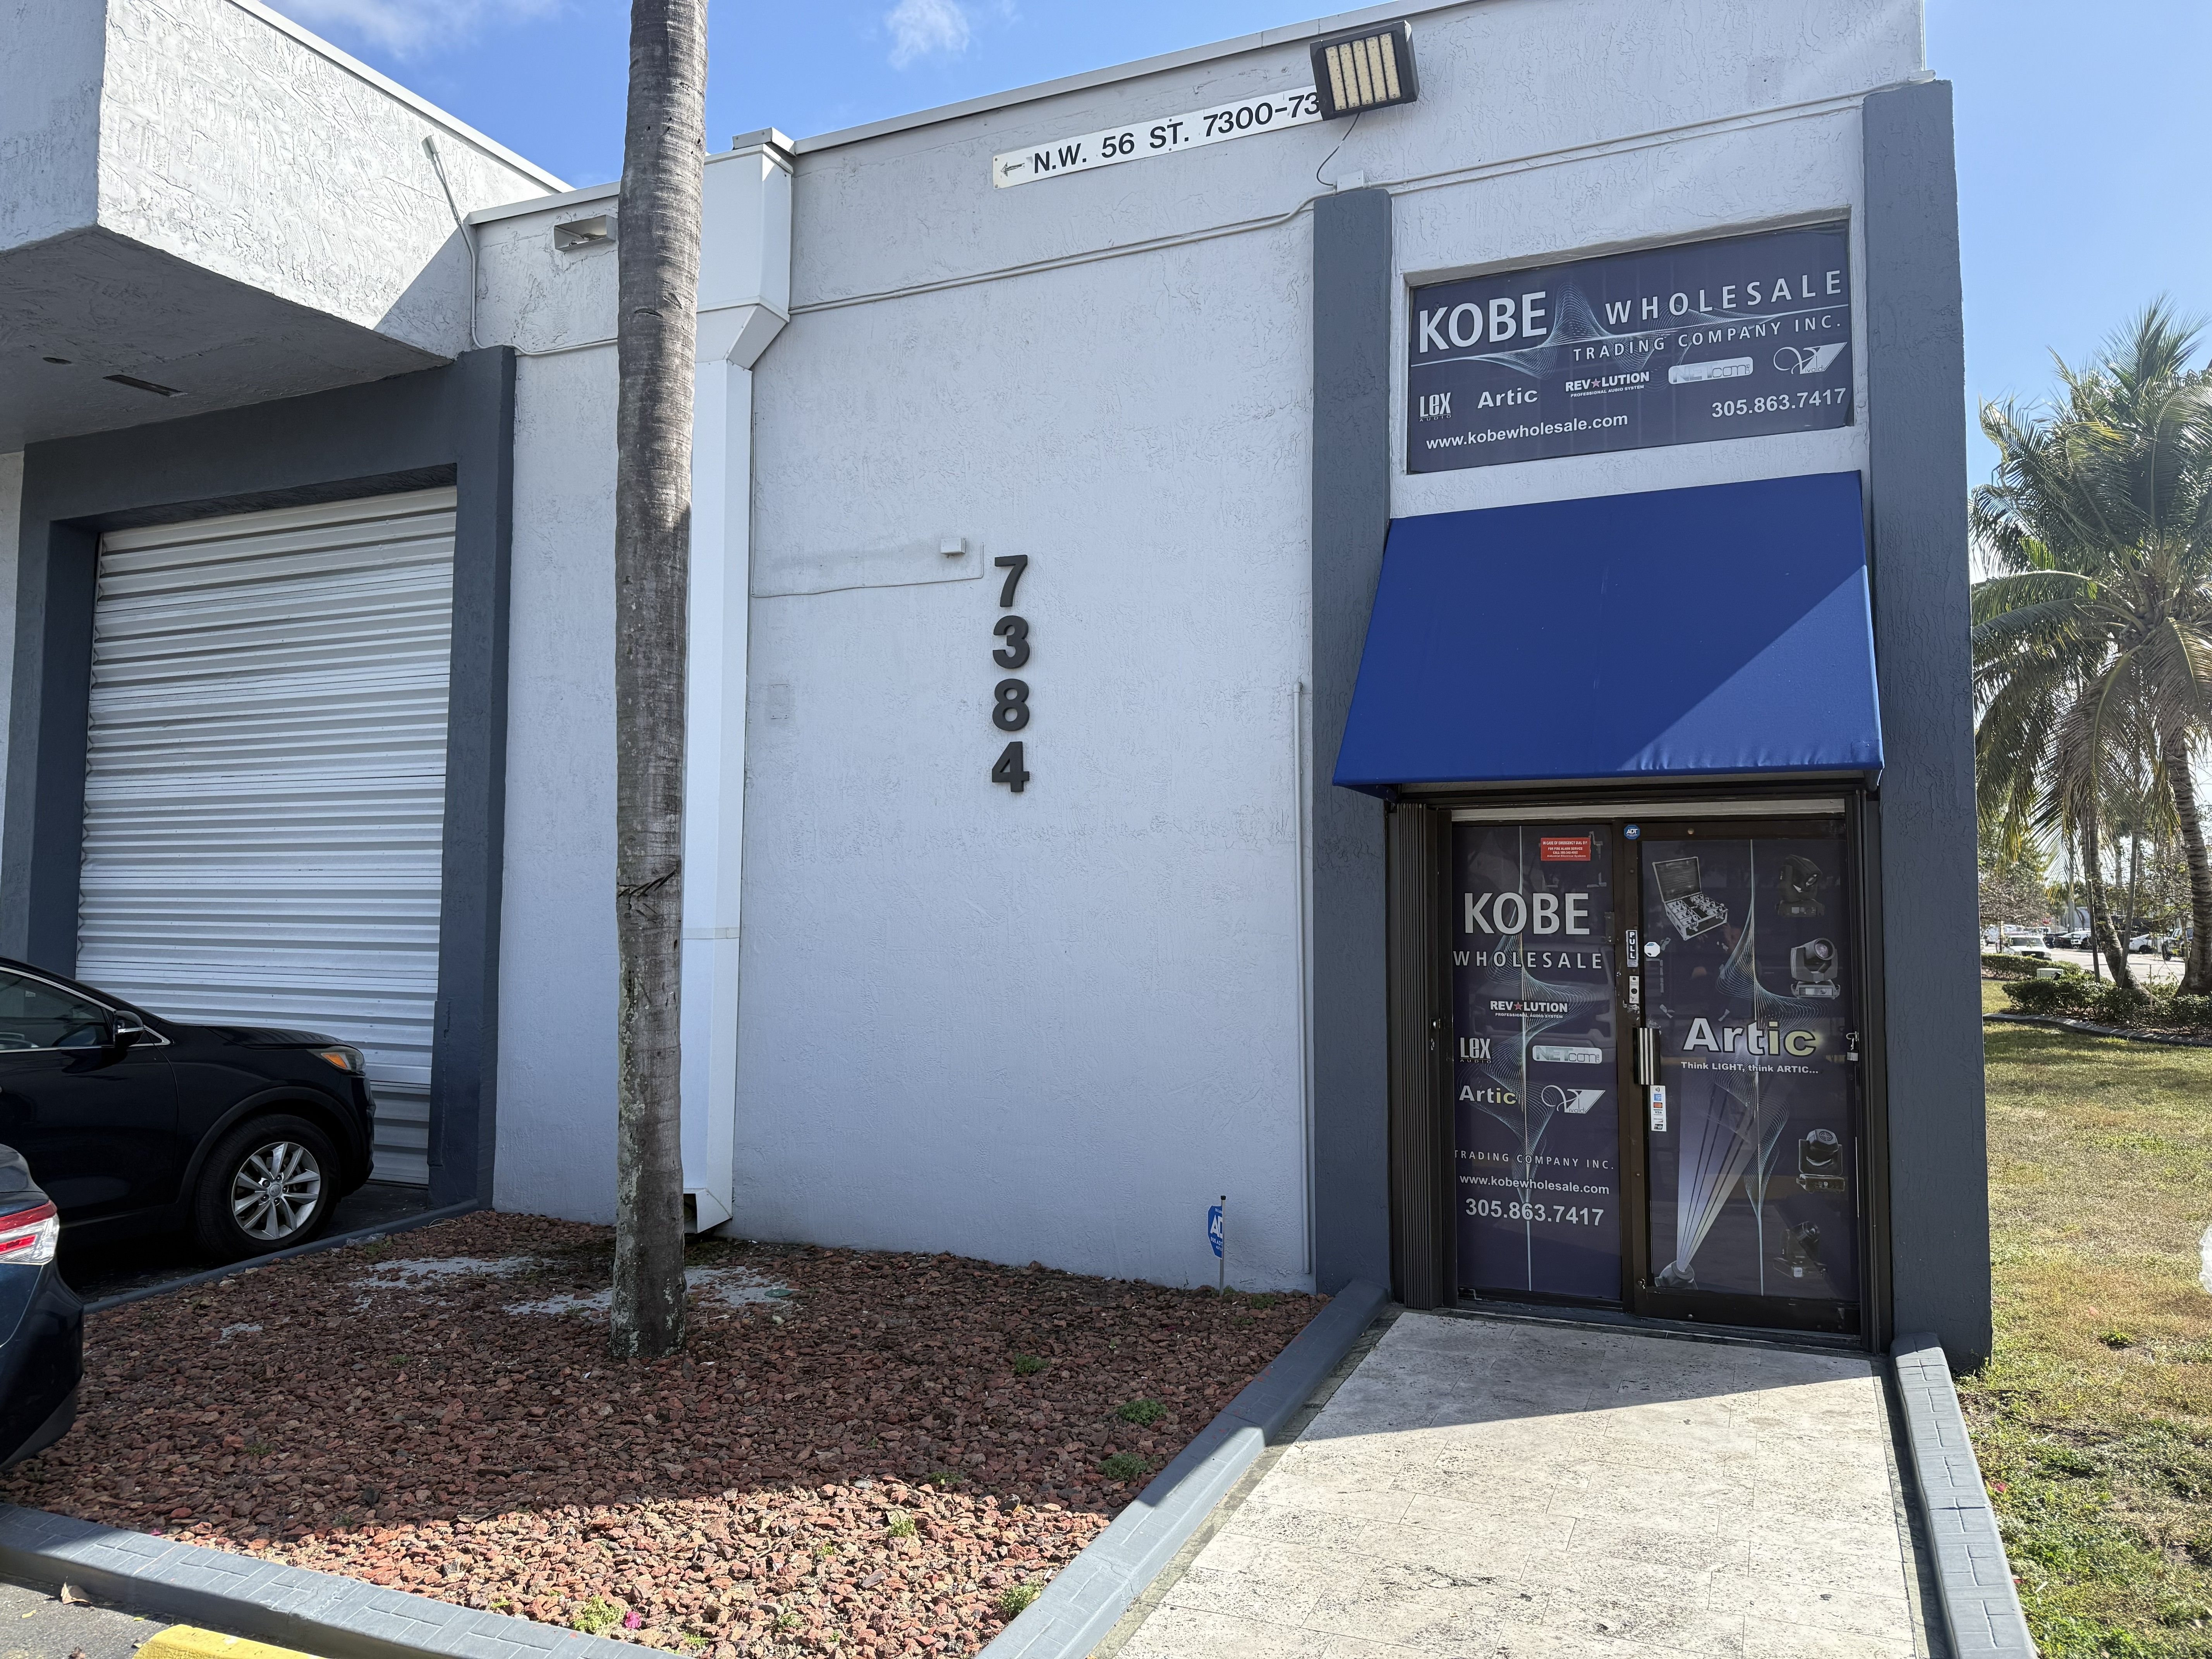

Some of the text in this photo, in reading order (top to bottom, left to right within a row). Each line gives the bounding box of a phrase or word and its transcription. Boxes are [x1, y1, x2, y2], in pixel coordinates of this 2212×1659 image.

[1034, 143, 1087, 174] N.W.
[1101, 132, 1135, 158] 56
[1149, 122, 1189, 149] ST.
[1606, 270, 1841, 325] WHOLESALE
[1419, 291, 1547, 353] KOBE
[1573, 315, 1841, 361] TRADING COMPANY INC.
[1478, 388, 1538, 409] Artic
[1571, 389, 1607, 398] PROFESSIONAL
[1712, 388, 1846, 417] 305.863.7417
[1426, 414, 1628, 449] www.kobewholesale.com
[992, 555, 1030, 792] 7384
[1465, 892, 1590, 934] KOBE
[1453, 951, 1602, 969] WHOLESALE
[1683, 1017, 1817, 1056] Artic
[1712, 1063, 1745, 1072] LIGHT,
[1777, 1065, 1818, 1073] ARTIC...
[1459, 1085, 1516, 1104] Artic
[1455, 1150, 1614, 1169] TRADING COMPANY INC.
[1460, 1175, 1609, 1194] www.kobewholesale.com
[1466, 1198, 1604, 1226] 305.863.7417
